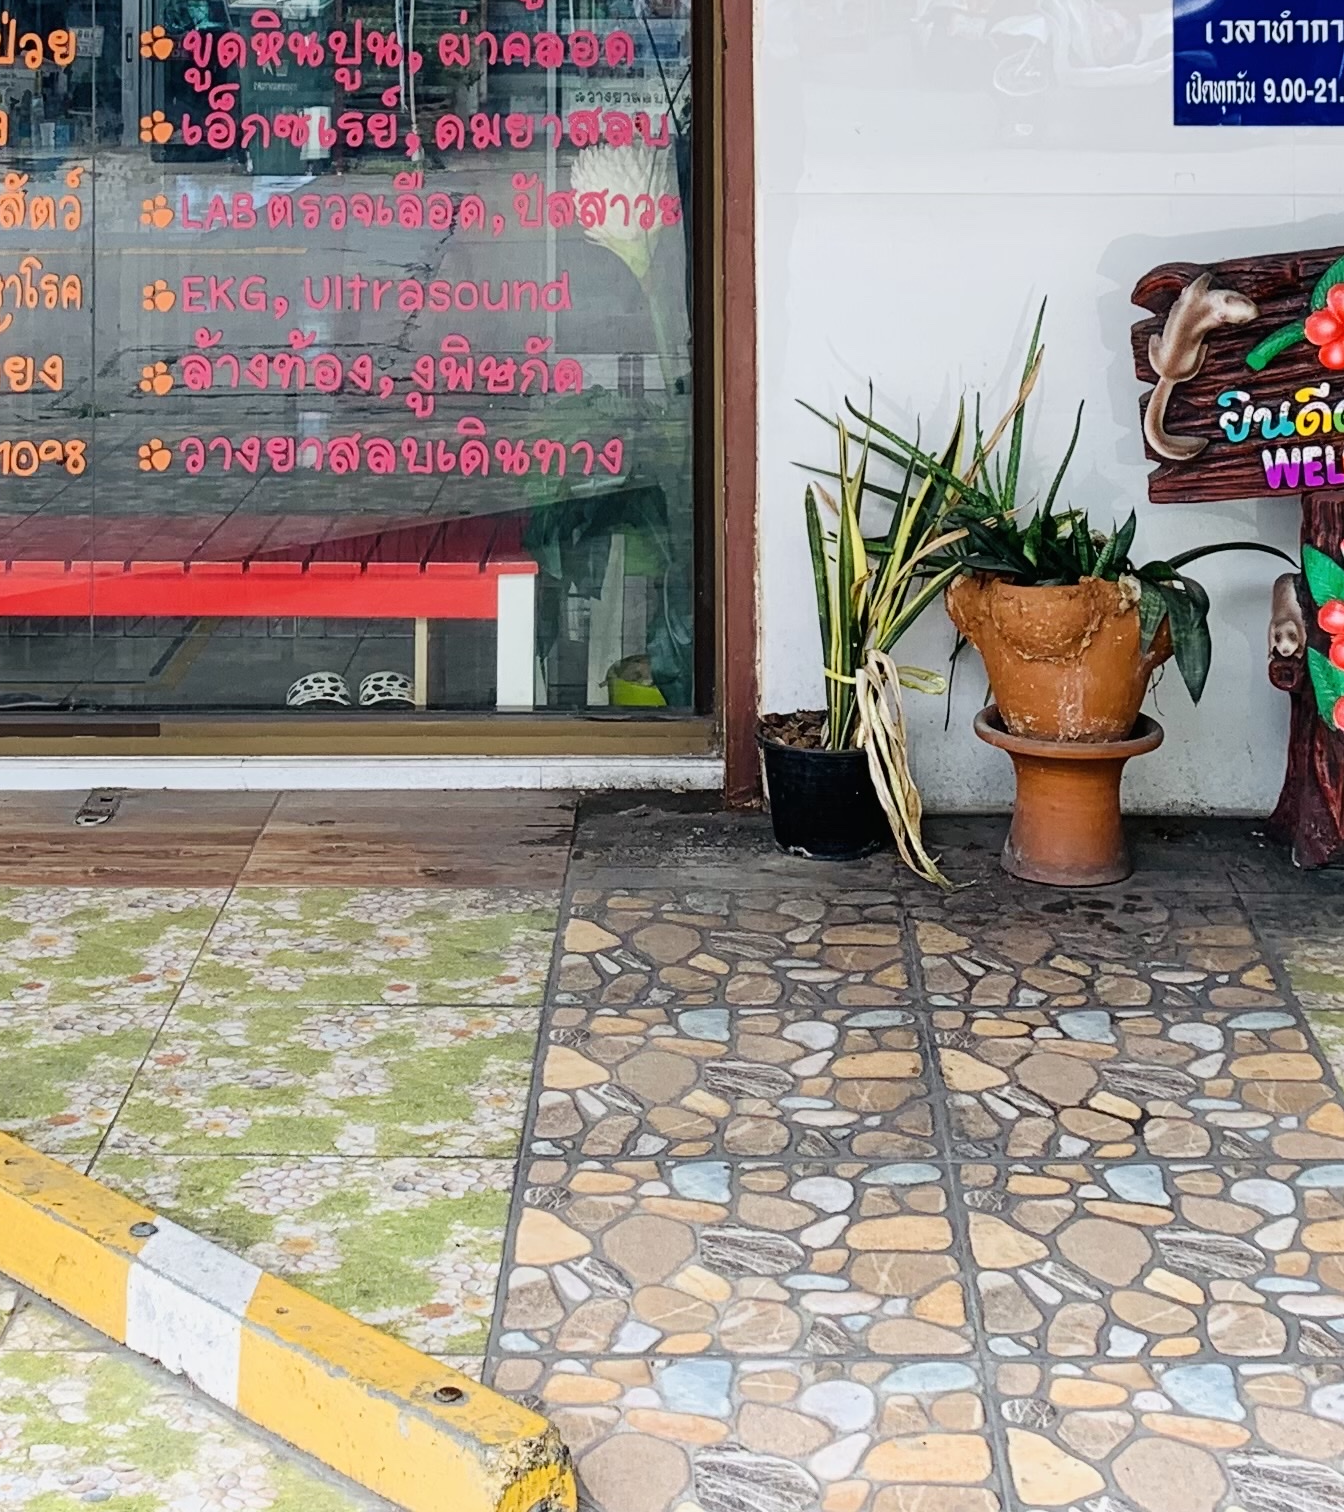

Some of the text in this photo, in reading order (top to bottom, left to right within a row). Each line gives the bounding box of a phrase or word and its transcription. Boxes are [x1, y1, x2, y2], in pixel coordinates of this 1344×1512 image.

[438, 9, 636, 69] ผ่าคลอด
[1185, 69, 1256, 115] เปิดทุกวัน
[436, 106, 670, 151] ดมยาสลบ
[181, 191, 257, 230] LAB
[513, 172, 683, 230] ปัสสาวะ
[303, 271, 574, 314] Ultrasound
[410, 333, 584, 419] งูพิษกัด
[179, 415, 625, 476] วางยาสลบเดินทาง
